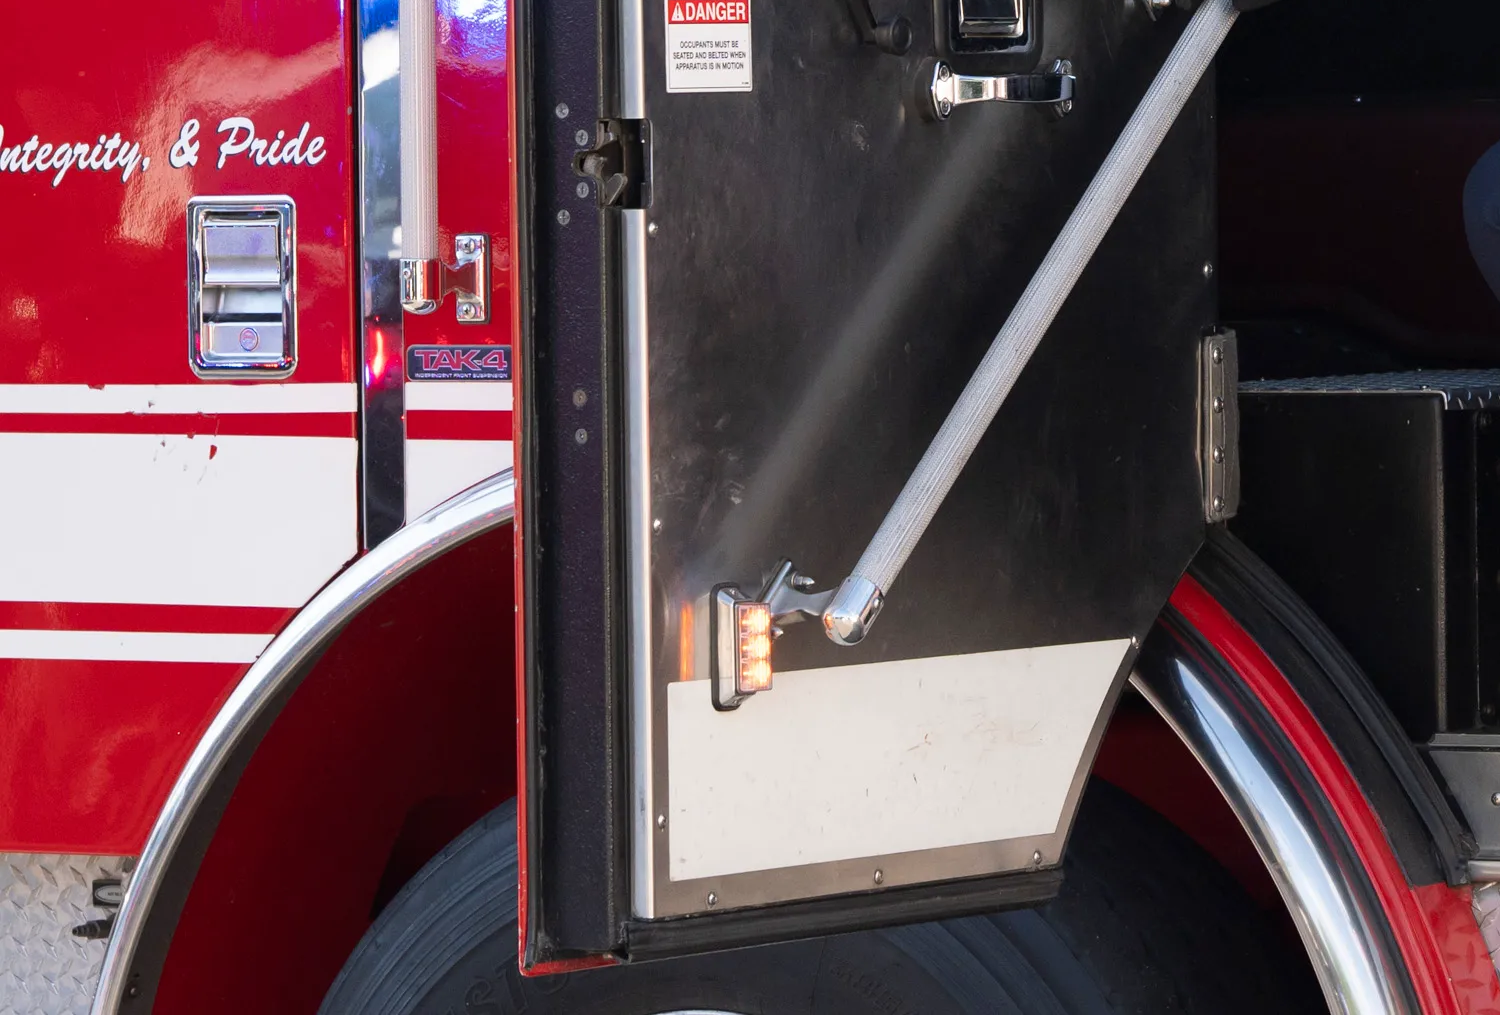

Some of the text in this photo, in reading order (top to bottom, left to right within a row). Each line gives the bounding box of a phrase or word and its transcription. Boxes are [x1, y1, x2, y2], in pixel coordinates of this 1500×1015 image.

[686, 2, 746, 21] DANGER
[680, 41, 714, 49] OCCUPANTS
[732, 40, 739, 48] BE
[673, 52, 694, 60] SEATED
[695, 52, 707, 60] AND
[708, 52, 728, 60] BELTED
[676, 63, 708, 71] APPARATUS
[716, 62, 722, 70] IN
[722, 62, 744, 70] MOTION
[0, 116, 327, 188] ntegrity, & Pride
[414, 350, 508, 370] TAK-4
